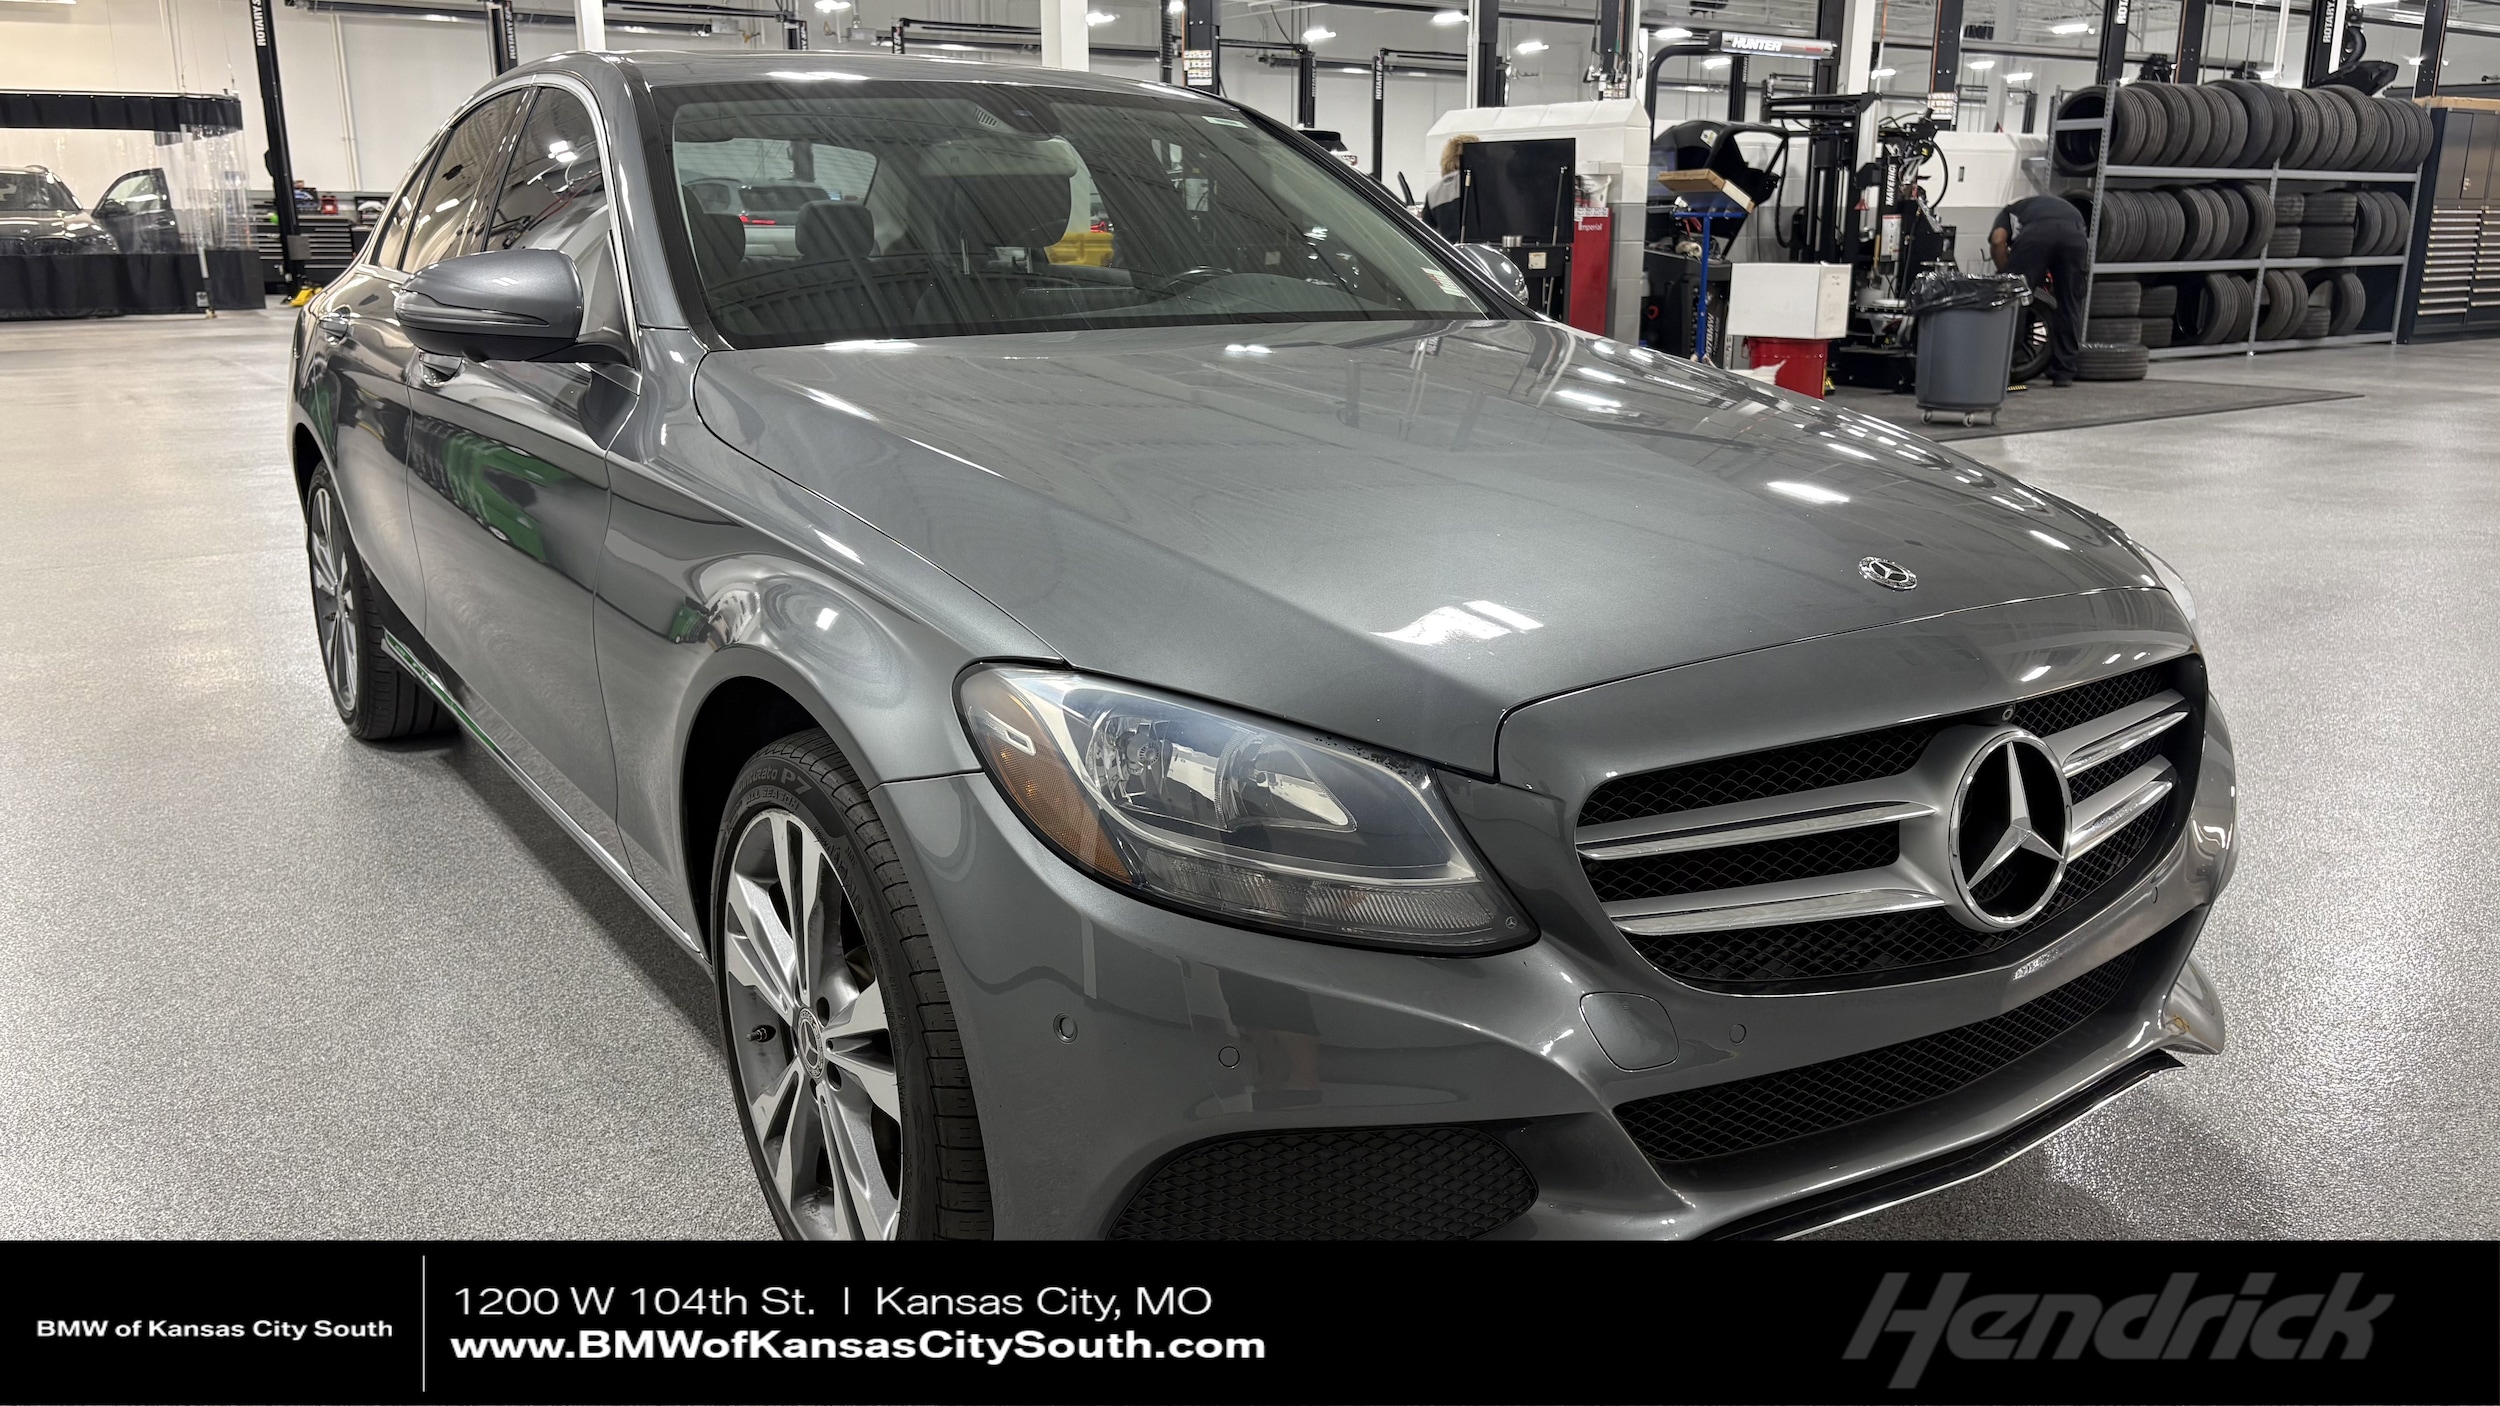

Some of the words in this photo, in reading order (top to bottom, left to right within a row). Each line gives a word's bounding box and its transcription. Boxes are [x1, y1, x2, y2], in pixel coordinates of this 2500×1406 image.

[253, 6, 267, 47] ROTARY
[2322, 1, 2335, 43] ROTARY
[1731, 37, 1783, 52] HUNTER
[1885, 163, 1897, 206] MAVERIC
[781, 767, 812, 795] P7
